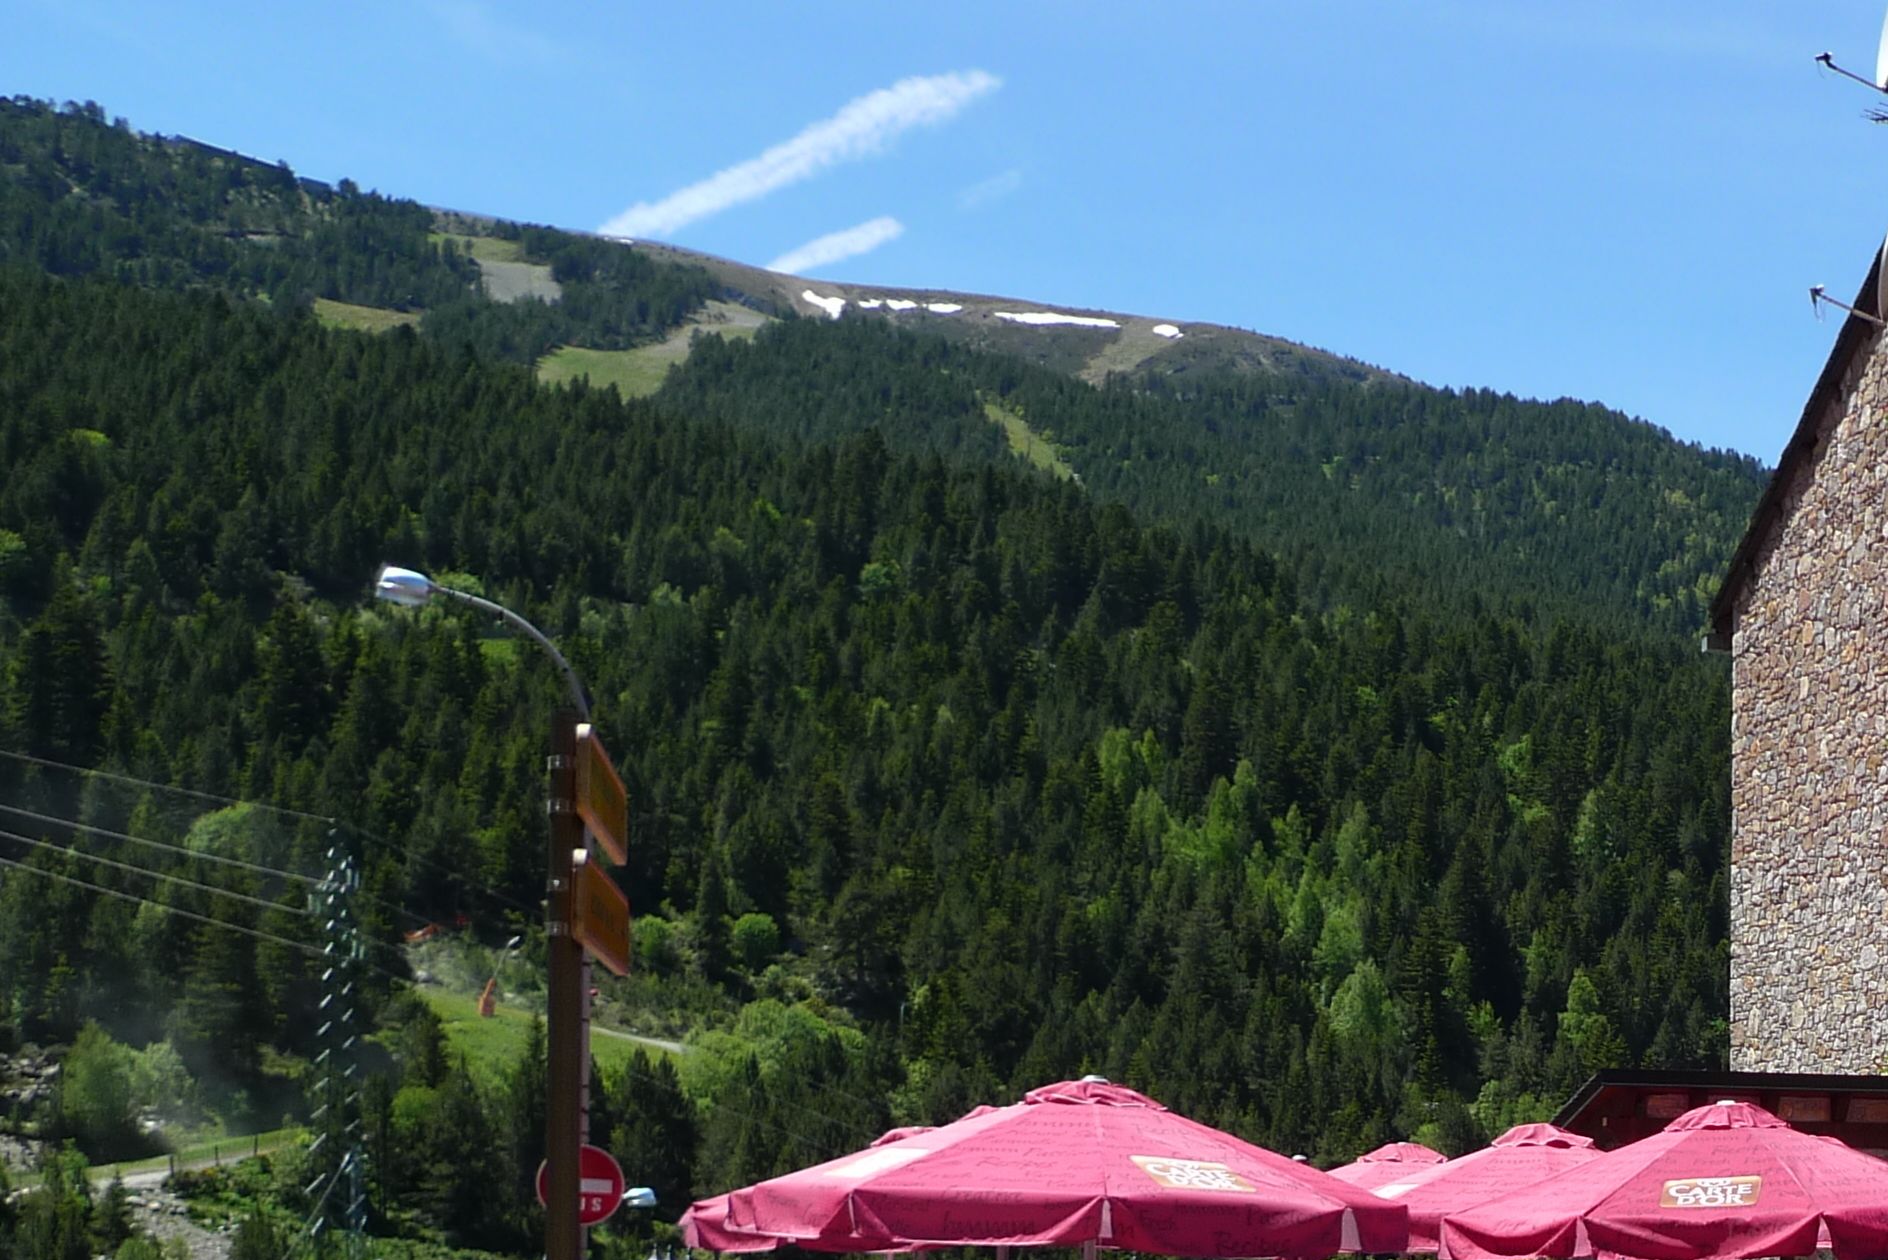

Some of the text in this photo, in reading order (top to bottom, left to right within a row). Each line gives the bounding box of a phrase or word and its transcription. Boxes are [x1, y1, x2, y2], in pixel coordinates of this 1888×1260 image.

[1146, 1161, 1236, 1184] CARTE
[1668, 1183, 1752, 1198] CARTE
[1677, 1194, 1744, 1206] D'OR
